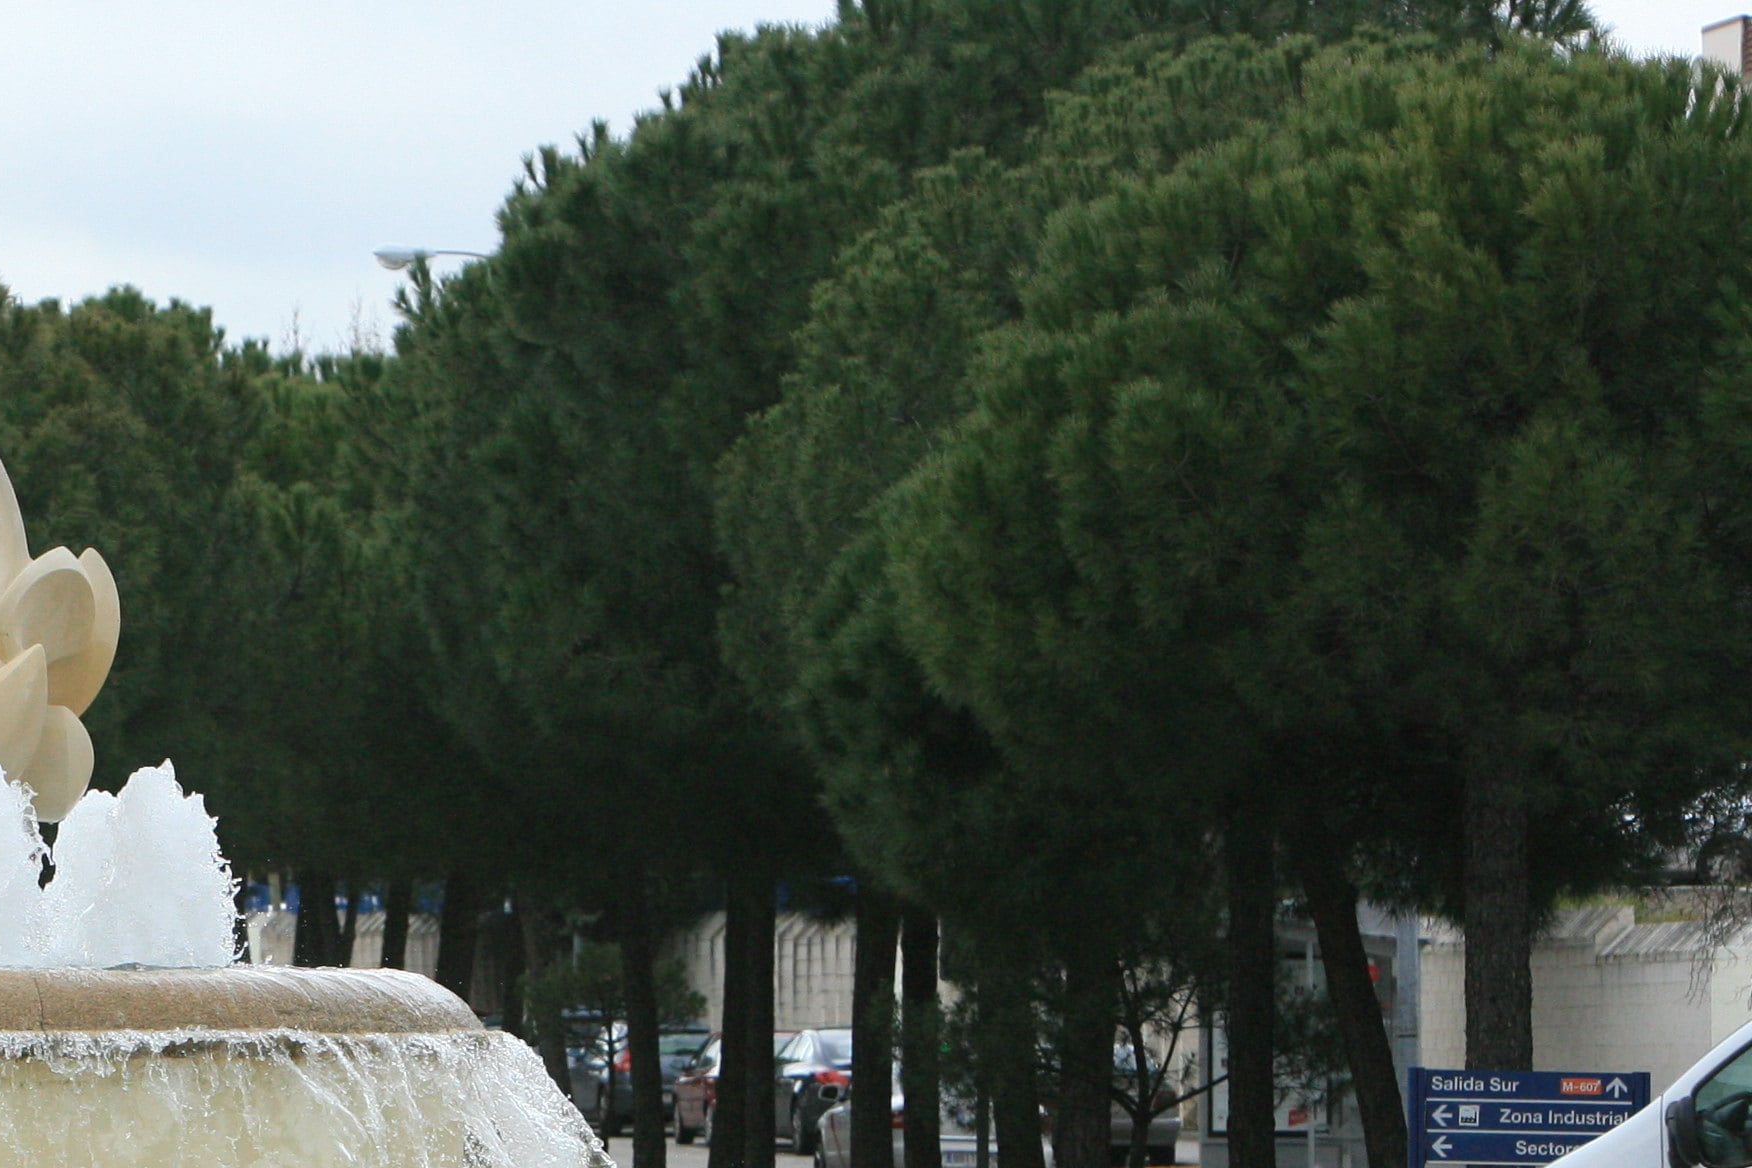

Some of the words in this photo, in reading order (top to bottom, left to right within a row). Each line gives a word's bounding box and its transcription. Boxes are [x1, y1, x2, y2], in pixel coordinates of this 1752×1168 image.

[1431, 1076, 1485, 1092] Salida
[1489, 1077, 1520, 1092] Sur
[1562, 1081, 1599, 1092] M-607
[1499, 1108, 1543, 1124] Zona
[1548, 1109, 1629, 1126] Industrial
